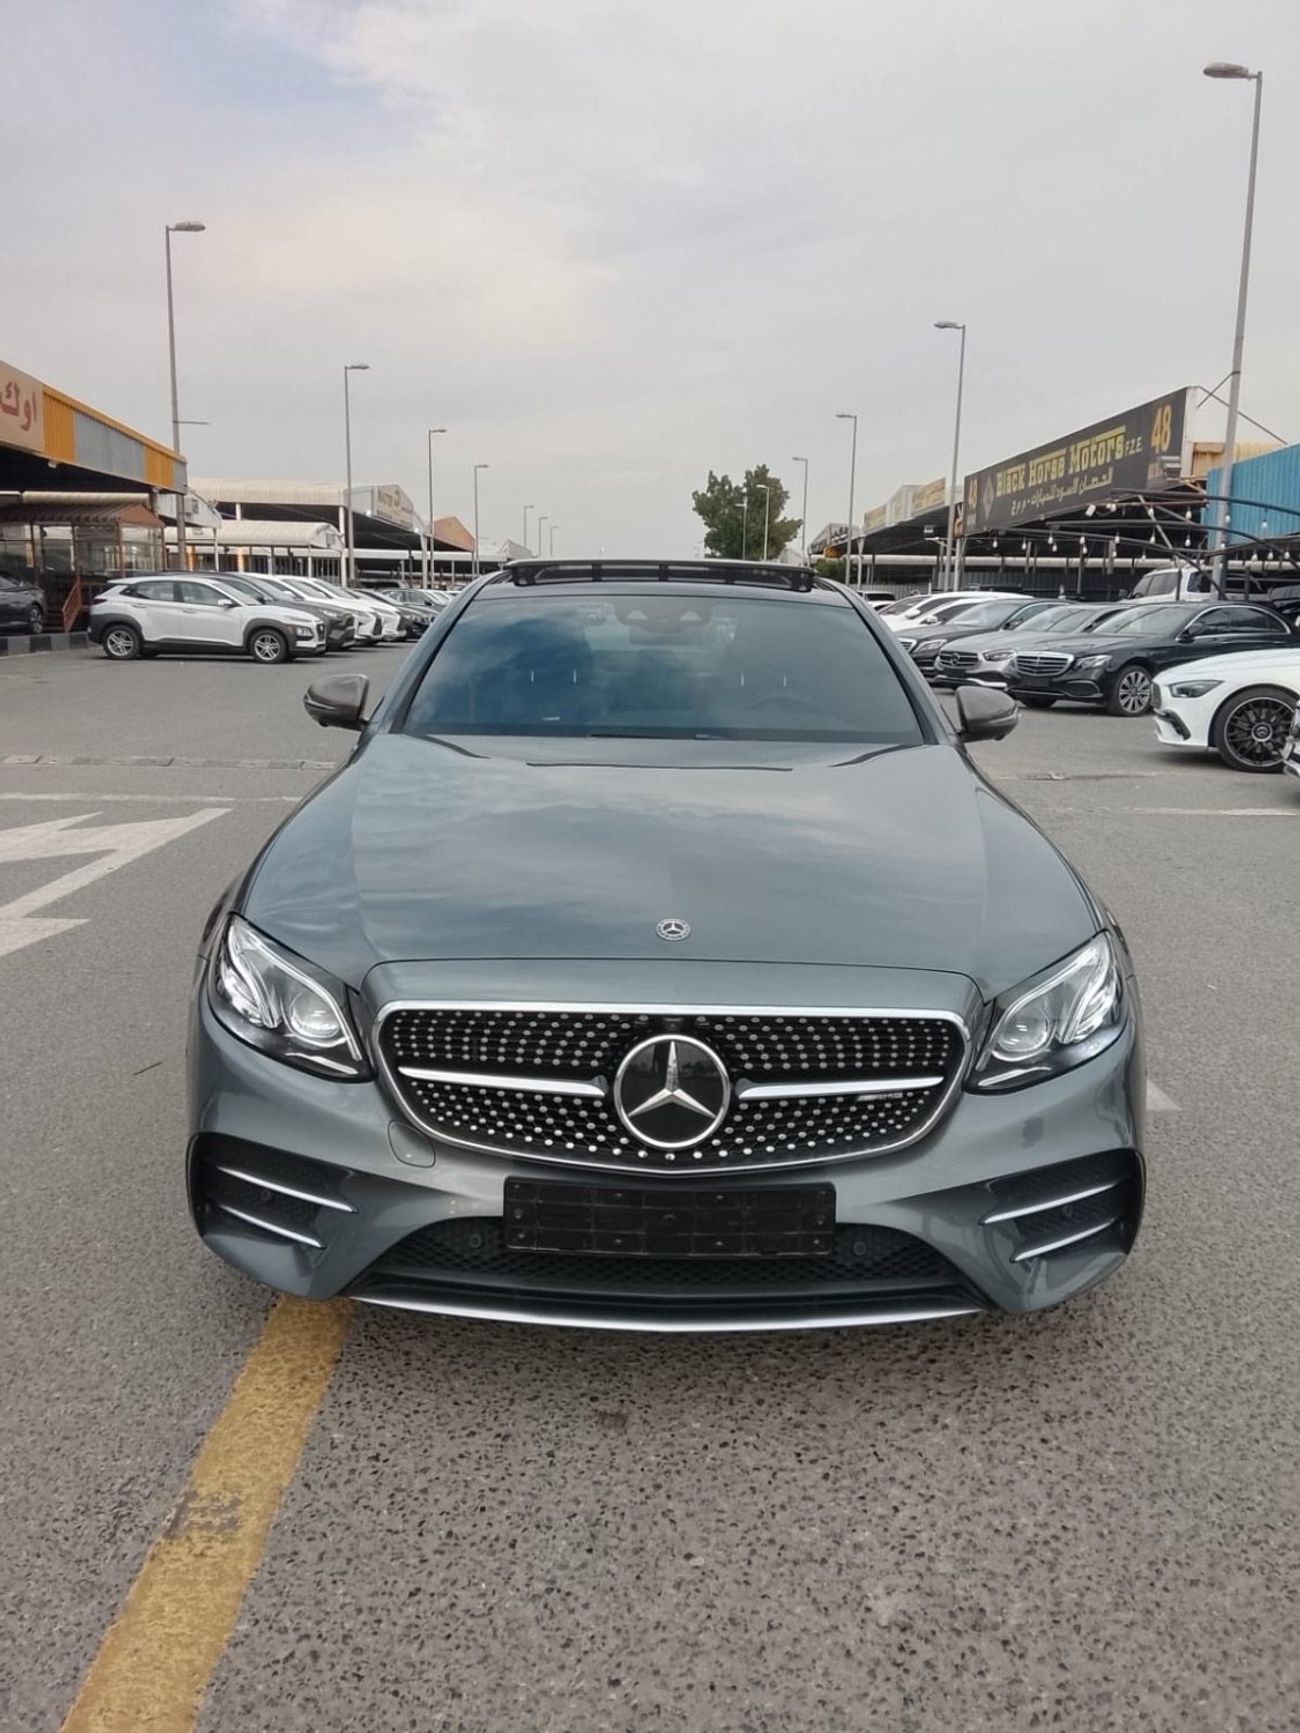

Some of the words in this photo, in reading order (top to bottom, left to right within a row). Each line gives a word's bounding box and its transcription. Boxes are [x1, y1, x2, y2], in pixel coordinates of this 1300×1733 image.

[1150, 404, 1172, 454] 48
[996, 462, 1026, 497] Black
[1028, 447, 1067, 488] Horse
[1068, 425, 1126, 475] Motors
